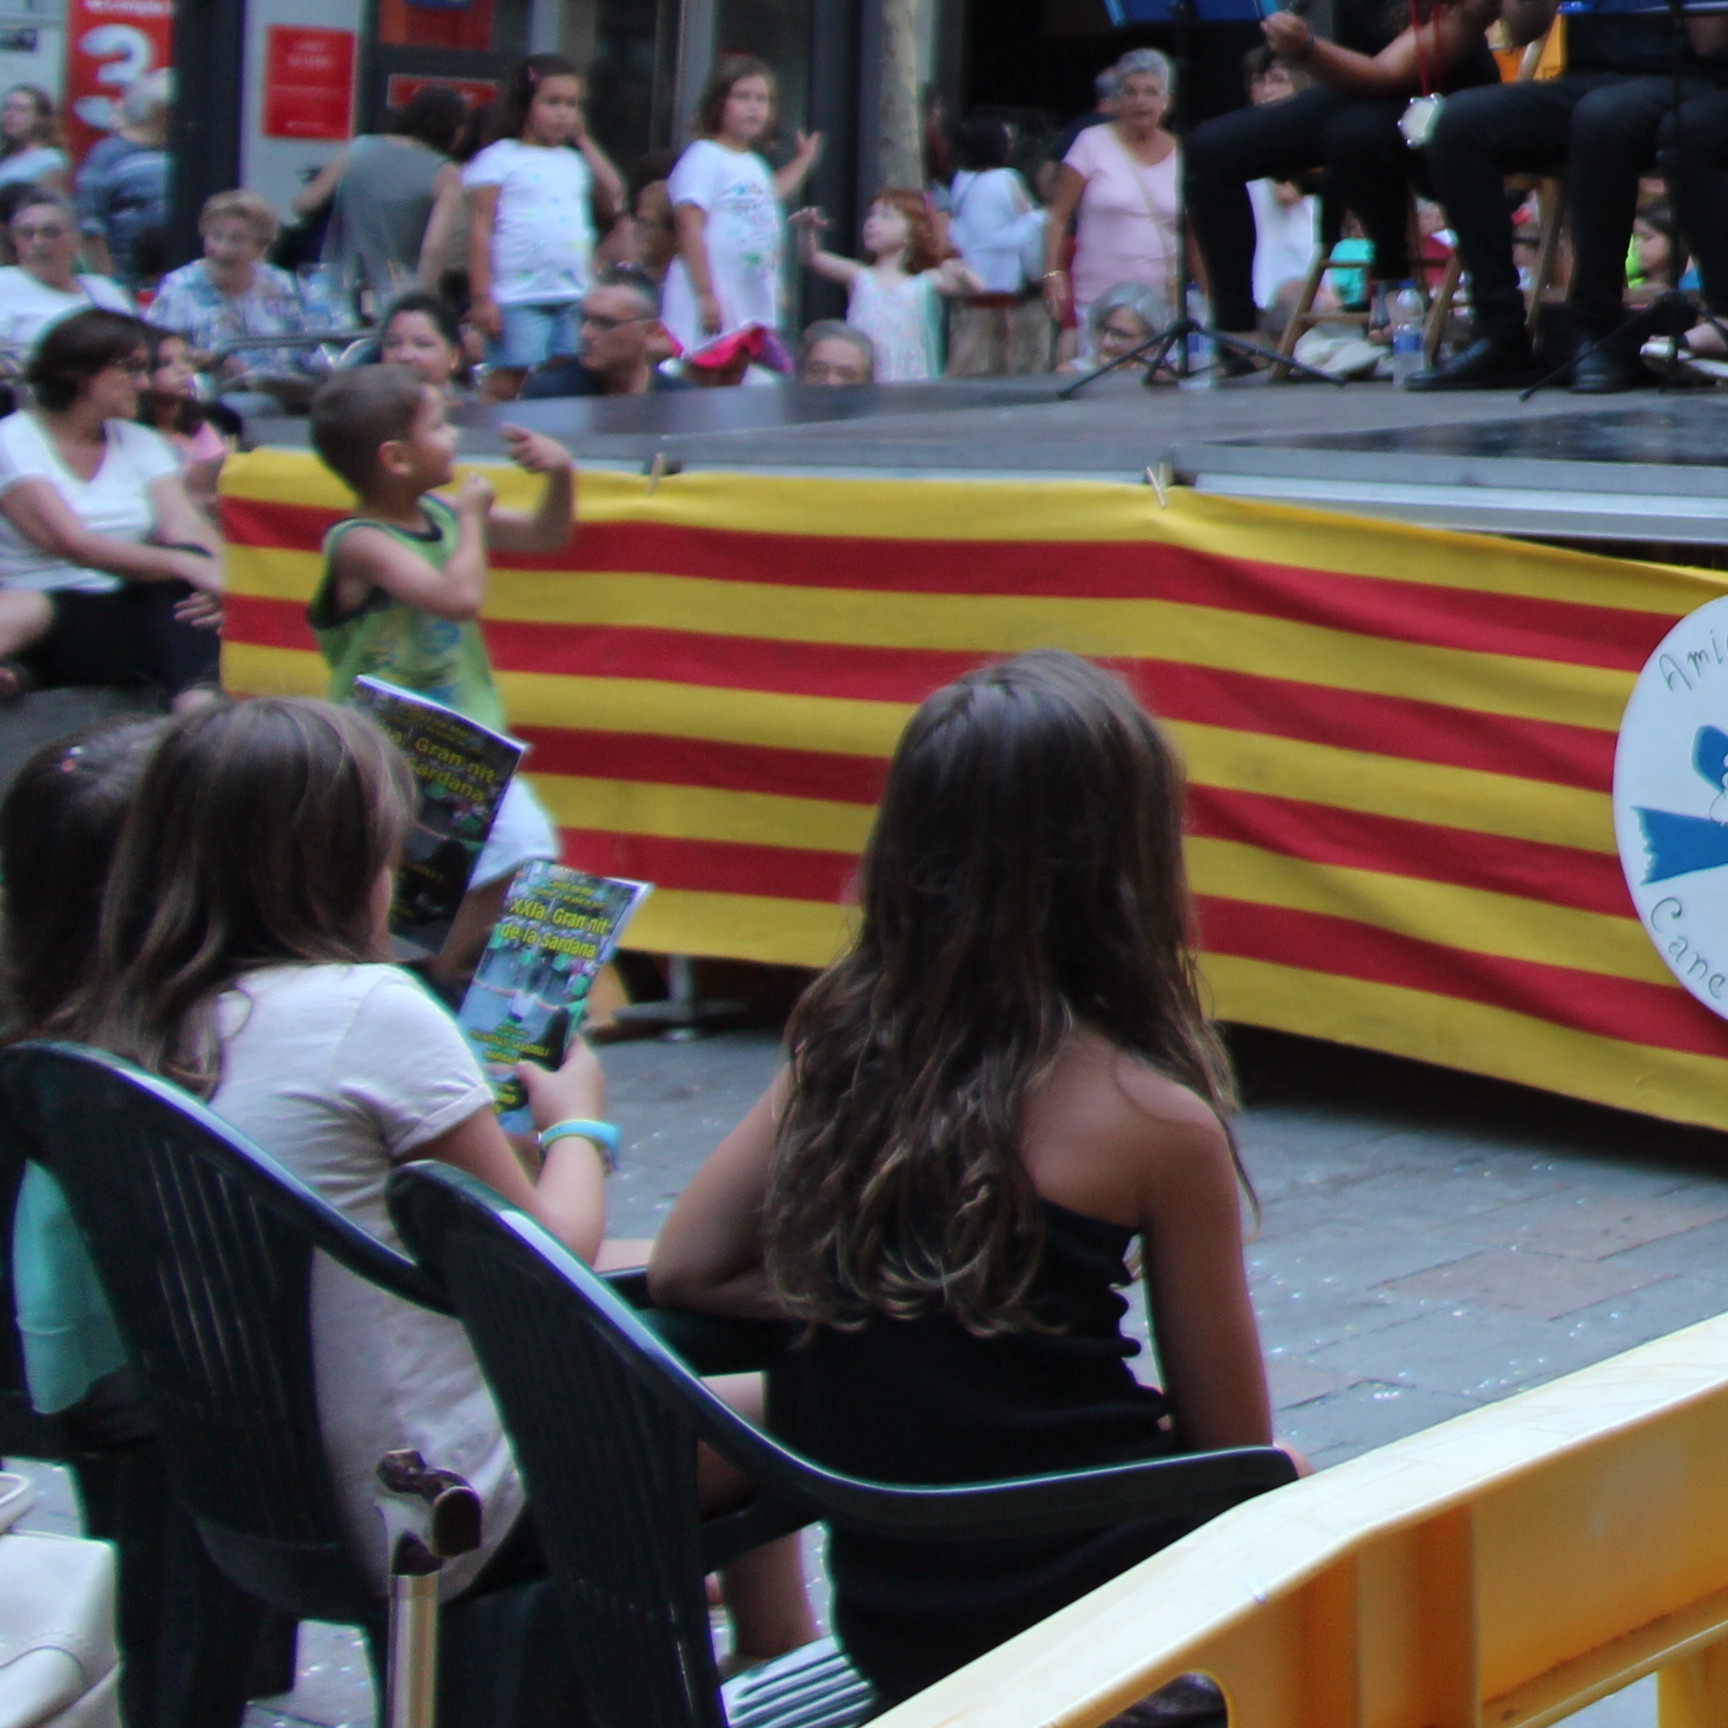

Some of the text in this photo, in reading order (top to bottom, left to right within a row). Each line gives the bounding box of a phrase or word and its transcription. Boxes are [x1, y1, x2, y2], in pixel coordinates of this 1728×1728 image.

[415, 737, 465, 767] Gran
[466, 762, 496, 783] nit
[502, 923, 520, 939] de
[522, 926, 537, 944] la
[552, 907, 587, 929] Gran
[588, 916, 610, 934] nit
